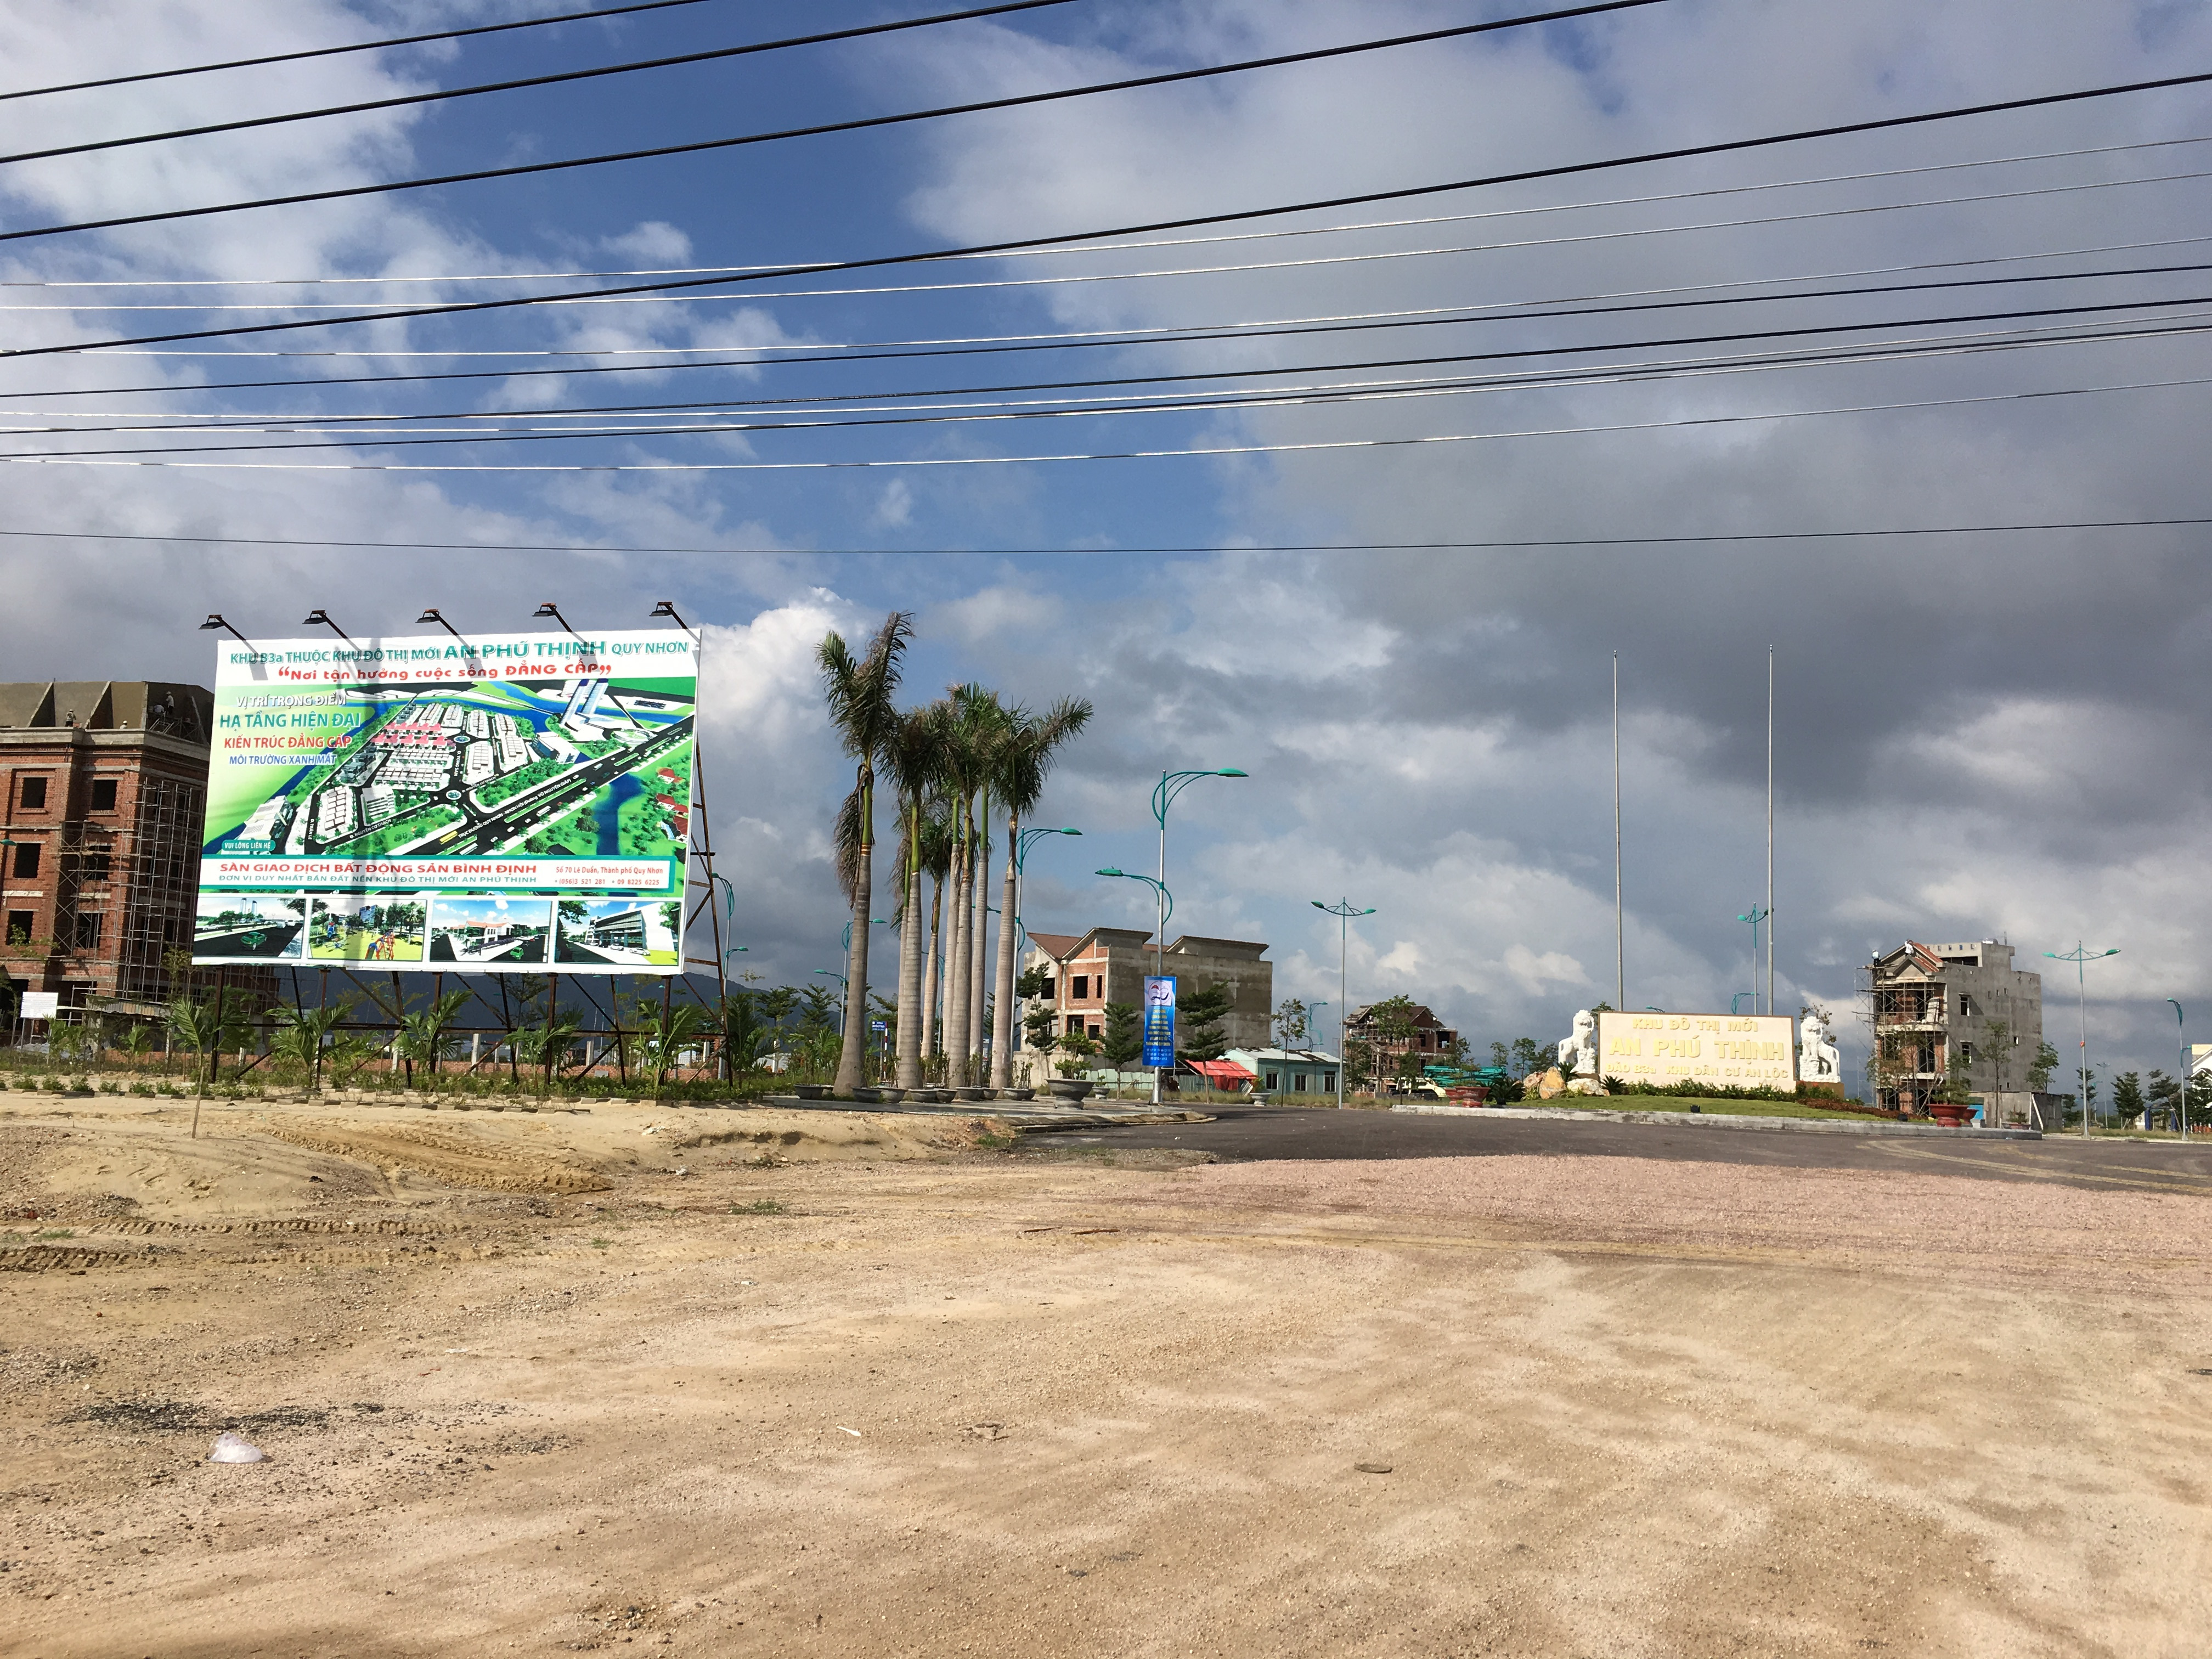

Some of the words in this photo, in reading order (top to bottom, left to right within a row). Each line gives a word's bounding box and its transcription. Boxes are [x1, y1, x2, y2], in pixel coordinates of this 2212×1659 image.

[230, 652, 258, 664] KHU
[261, 653, 283, 663] B3a
[286, 650, 330, 664] THUỘC
[333, 651, 362, 662] KHU
[364, 647, 384, 662] ĐÔ
[386, 650, 408, 663] THỊ
[411, 646, 440, 660] MỚI
[444, 645, 476, 659] AN
[483, 640, 531, 658] PHÚ
[534, 641, 606, 659] THỊNH
[612, 643, 644, 655] QUY
[646, 642, 689, 653] NHƠN
[324, 669, 350, 682] tận
[357, 668, 408, 680] hưởng
[415, 667, 451, 680] cuộc
[458, 663, 498, 678] sống
[506, 660, 557, 675] ĐẲNG
[236, 696, 247, 709] VỊ
[249, 694, 270, 707] TRÍ
[270, 696, 313, 709] TRỌNG
[220, 714, 240, 731] HẠ
[245, 710, 286, 727] TẦNG
[291, 711, 328, 731] HIỆN
[332, 713, 361, 731] ĐẠI
[224, 734, 251, 748] KIẾN
[253, 735, 285, 748] TRÚC
[287, 733, 324, 748] ĐẲNG
[327, 733, 352, 748] CẤP
[229, 754, 246, 765] MÔI
[249, 753, 287, 764] TRƯỜNG
[289, 755, 314, 764] XANH
[220, 862, 250, 871] SÀN
[253, 864, 290, 872] GIAO
[294, 864, 330, 874] DỊCH
[335, 862, 362, 872] BẤT
[365, 864, 412, 875] ĐỘNG
[417, 862, 449, 873] SẢN
[453, 864, 491, 873] BÌNH
[495, 865, 537, 875] ĐỊNH
[620, 866, 632, 874] phố
[1632, 1018, 1663, 1029] KHU
[1669, 1017, 1690, 1030] ĐÔ
[1696, 1020, 1720, 1034] THỊ
[1728, 1018, 1758, 1032] MỚI
[1609, 1037, 1641, 1056] AN
[1653, 1035, 1701, 1058] PHÚ
[1714, 1039, 1784, 1064] THỊNH
[1633, 1064, 1656, 1074] B3a
[1666, 1066, 1690, 1075] KHU
[1694, 1065, 1719, 1076] DÂN
[1724, 1067, 1741, 1076] CƯ
[1745, 1069, 1760, 1077] AN
[1764, 1067, 1788, 1080] LỘC
